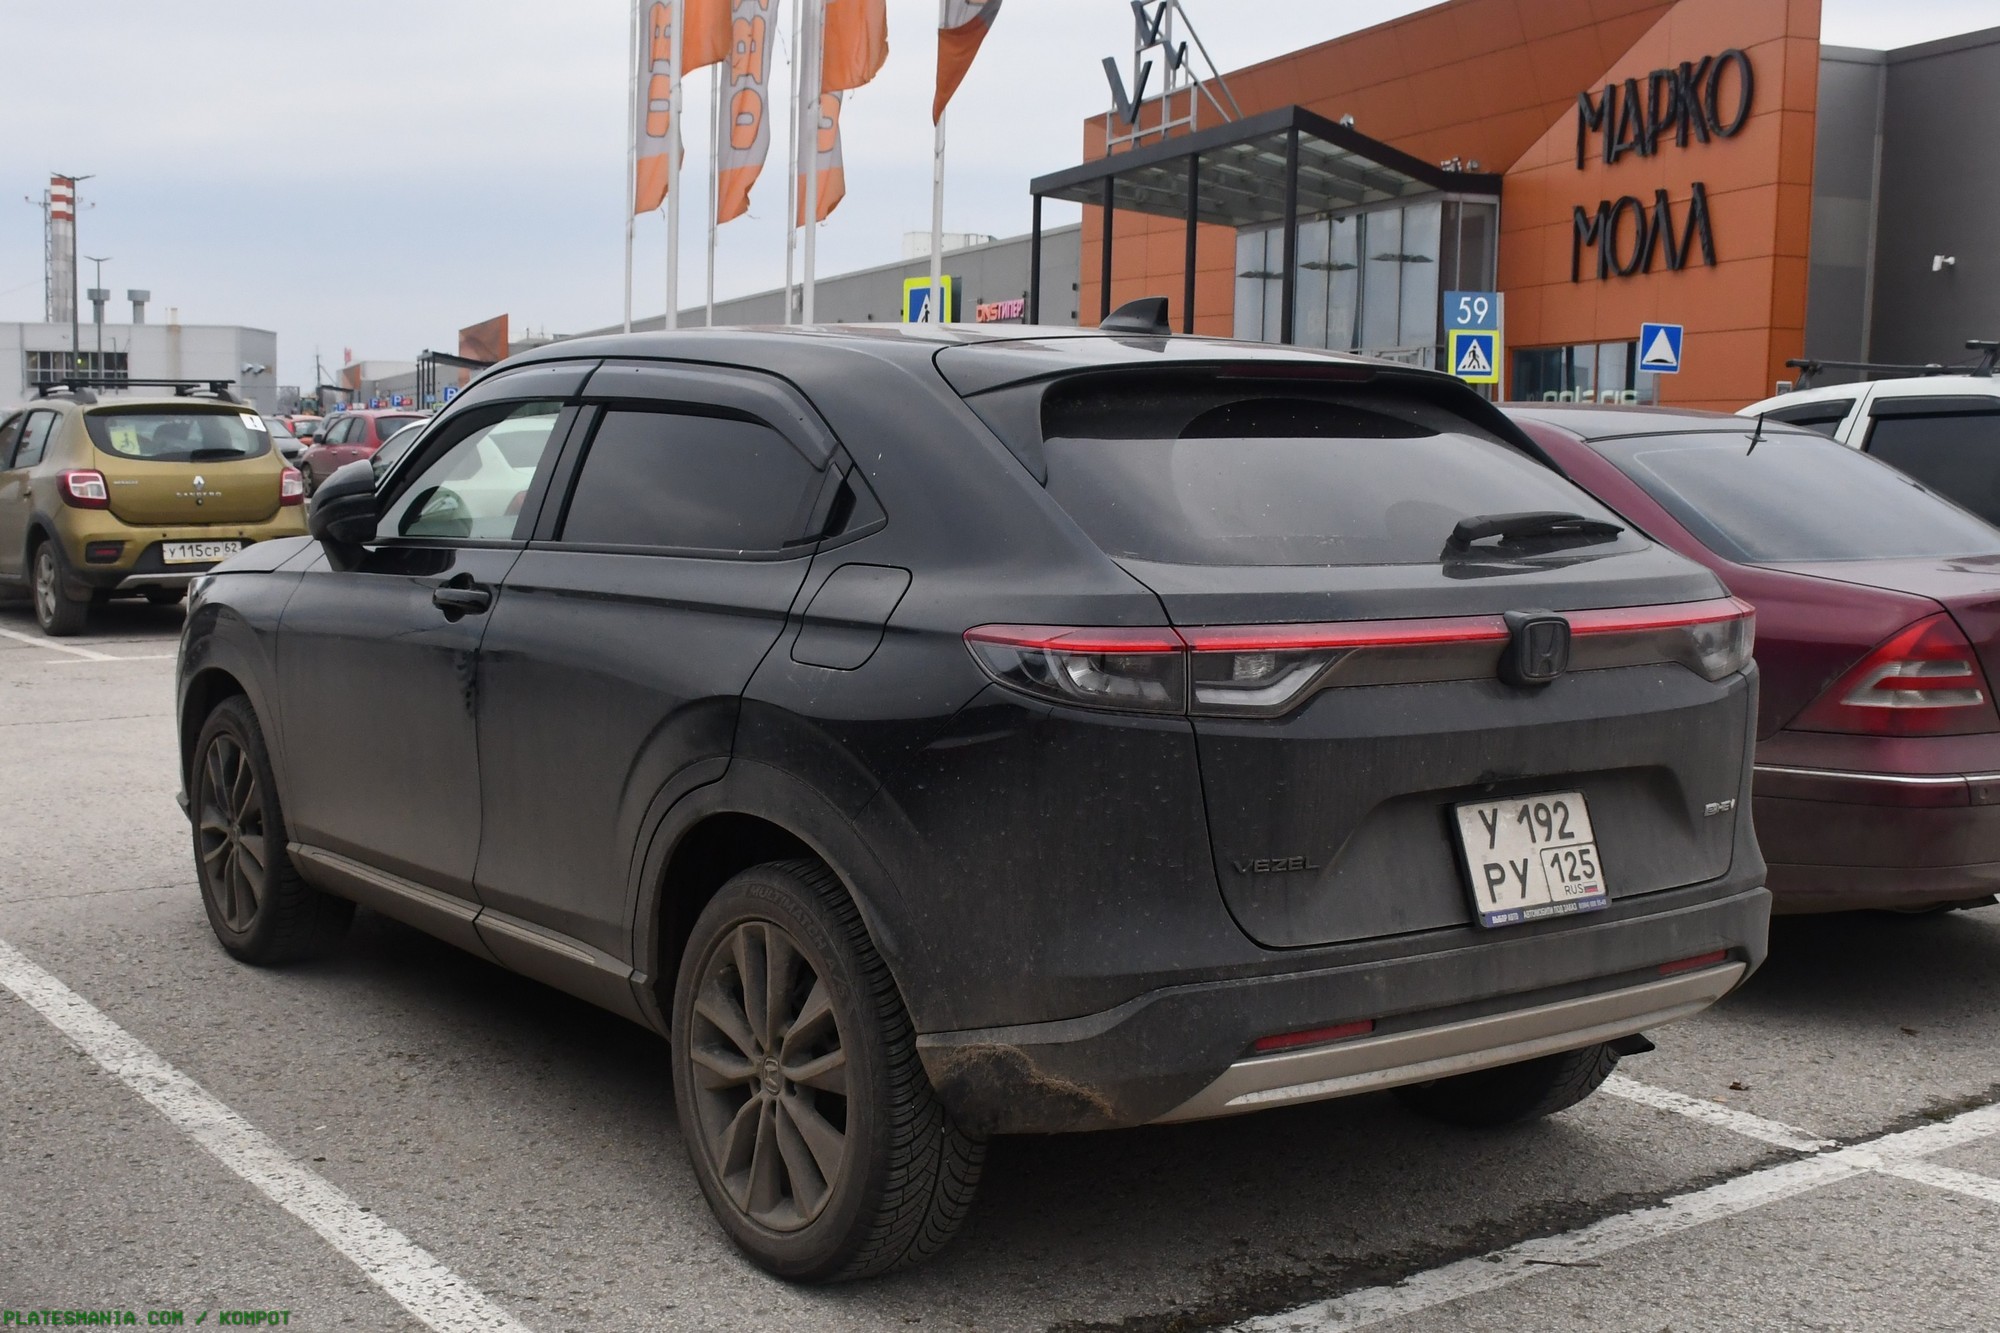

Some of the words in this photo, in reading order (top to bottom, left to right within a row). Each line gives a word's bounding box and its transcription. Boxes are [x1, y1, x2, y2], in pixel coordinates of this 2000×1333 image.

[1576, 48, 1754, 170] МАРКО
[1571, 182, 1717, 283] МОЛЛ
[1457, 296, 1489, 325] 59
[1478, 808, 1498, 849] У
[1517, 801, 1575, 843] 192
[1233, 855, 1320, 873] VEZEL
[1483, 858, 1528, 903] РУ
[1550, 849, 1595, 883] 125
[1564, 883, 1584, 896] RUS
